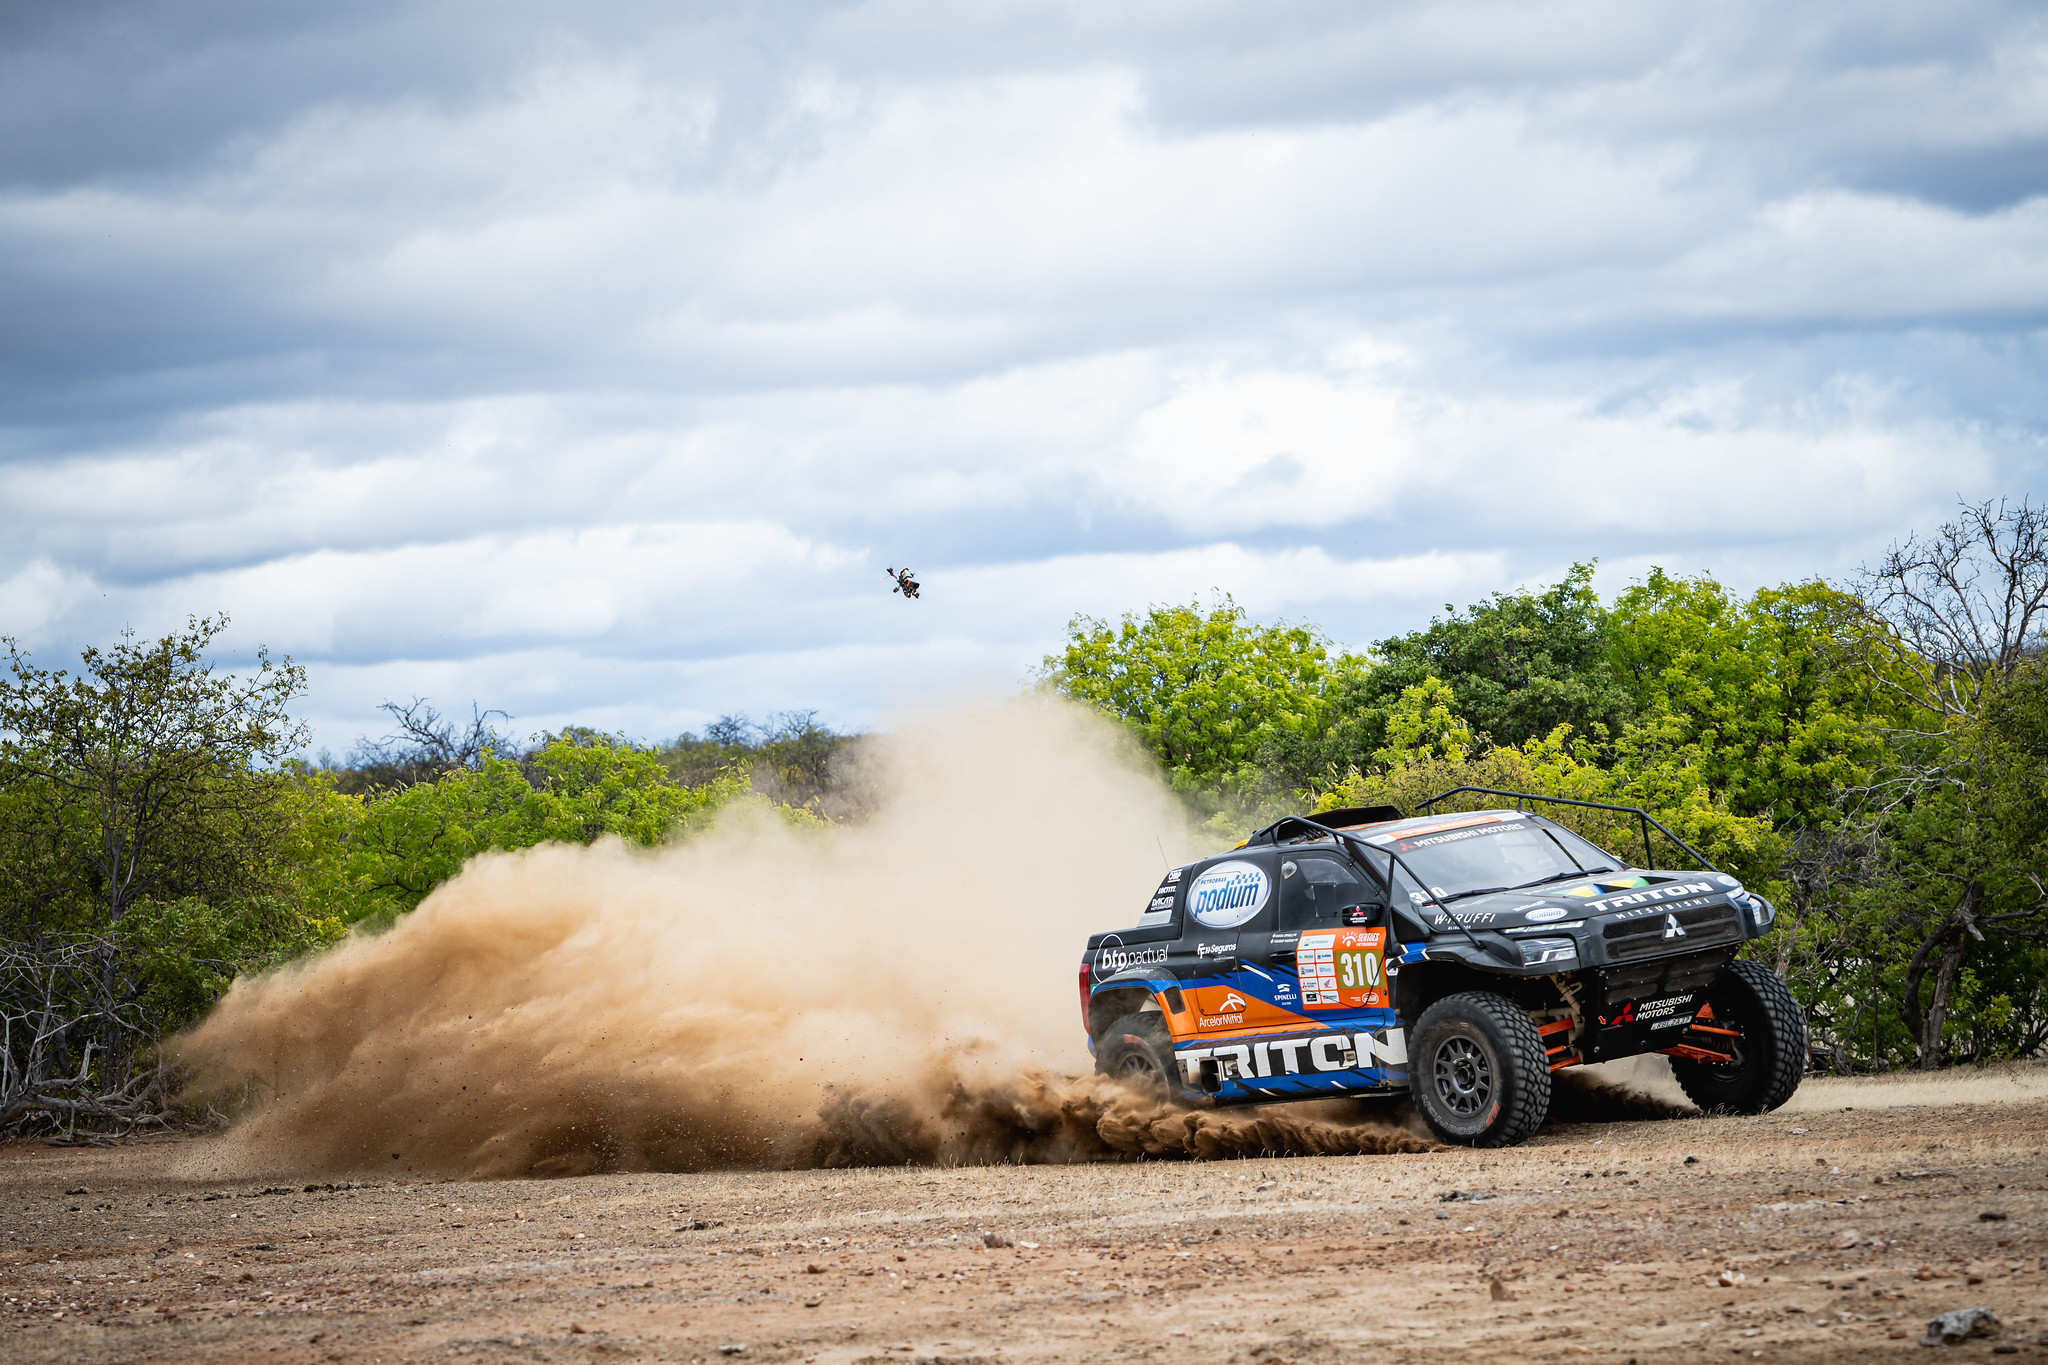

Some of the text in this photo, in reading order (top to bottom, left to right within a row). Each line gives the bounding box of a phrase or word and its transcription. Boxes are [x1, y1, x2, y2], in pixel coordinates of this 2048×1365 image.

[1413, 829, 1479, 848] MITSUBISHI
[1479, 823, 1526, 835] MOTORS
[1200, 876, 1227, 885] PETROBRAS
[1195, 880, 1260, 918] podium
[1584, 882, 1714, 912] TRITON
[1615, 898, 1711, 920] MITSUBISHI
[1210, 943, 1237, 955] Seguros
[1340, 952, 1381, 987] 310
[1636, 1006, 1675, 1021] MOTORS
[1639, 994, 1693, 1012] MITSUBISHI
[1199, 1013, 1243, 1028] ArcelorMittal
[1175, 1027, 1408, 1083] TRITON
